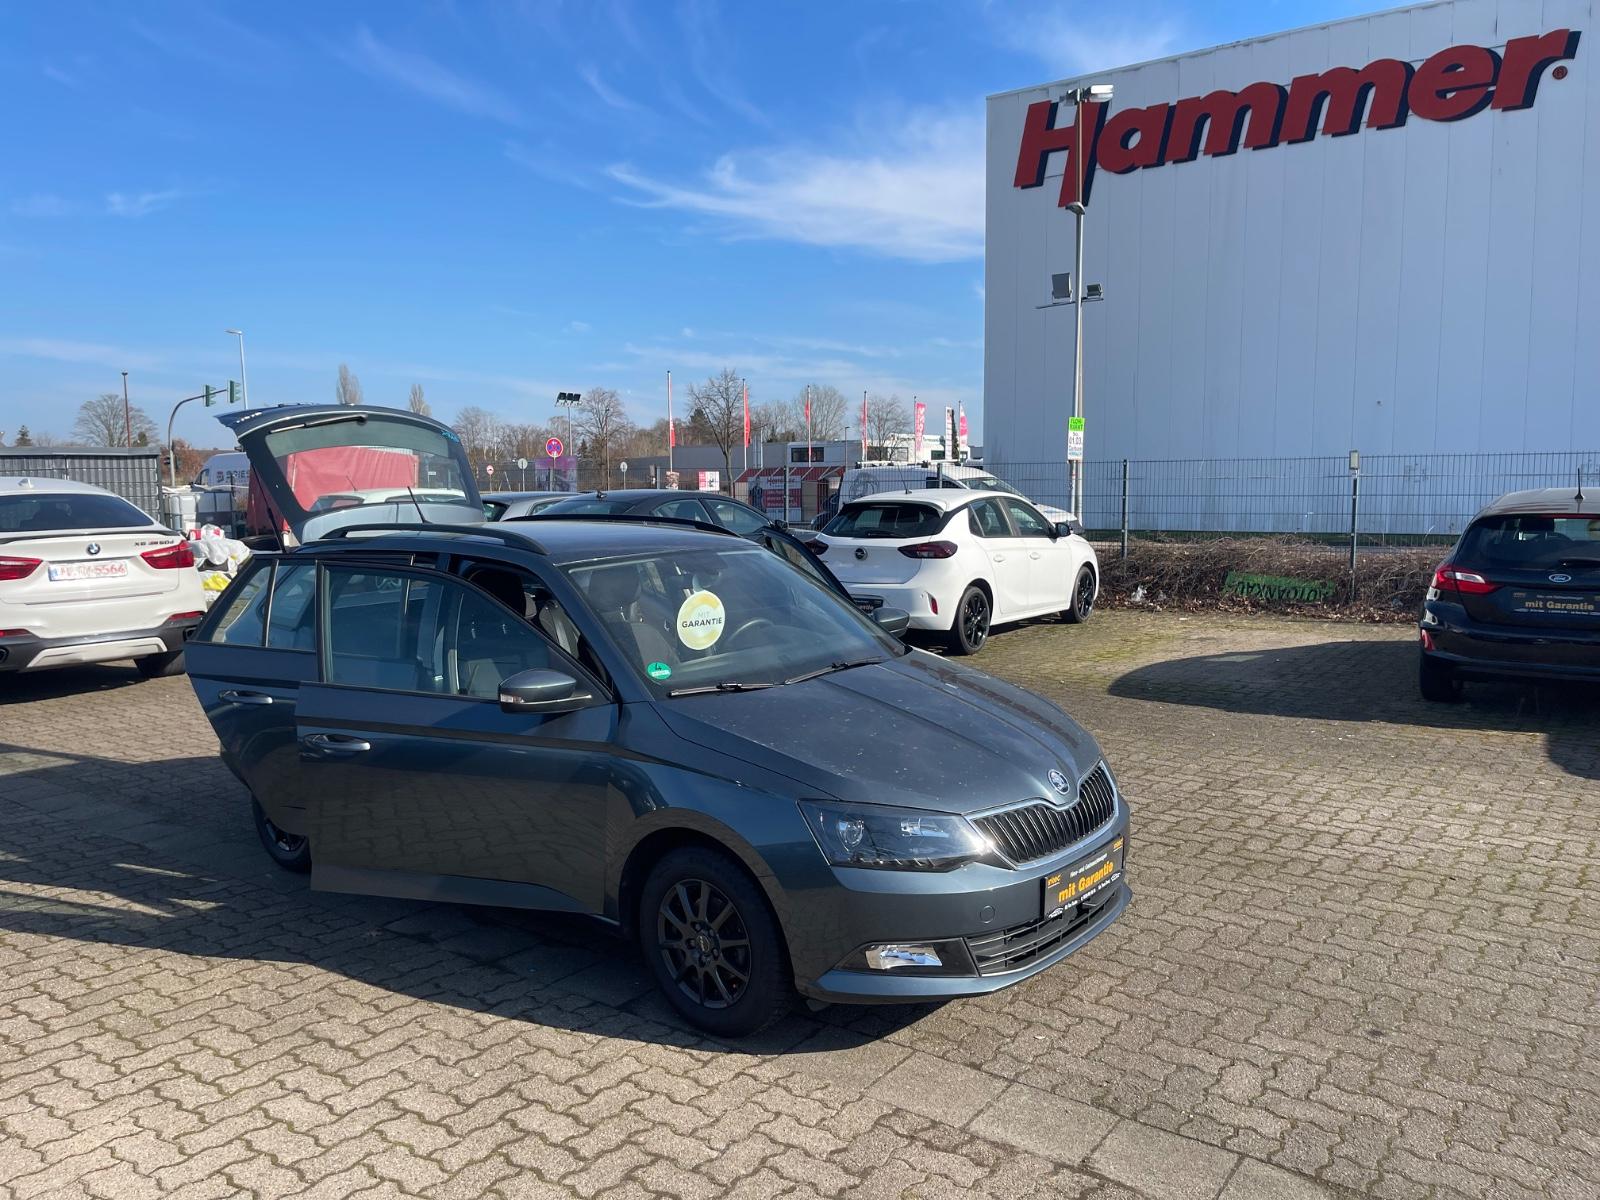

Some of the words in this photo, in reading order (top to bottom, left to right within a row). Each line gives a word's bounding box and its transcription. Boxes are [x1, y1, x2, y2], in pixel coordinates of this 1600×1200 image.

[1013, 29, 1581, 207] Hammer
[1525, 600, 1543, 608] mit
[1546, 601, 1594, 611] Garantie
[682, 617, 723, 628] GARANTIE
[1059, 882, 1076, 903] mit
[1078, 860, 1114, 891] Garantie
